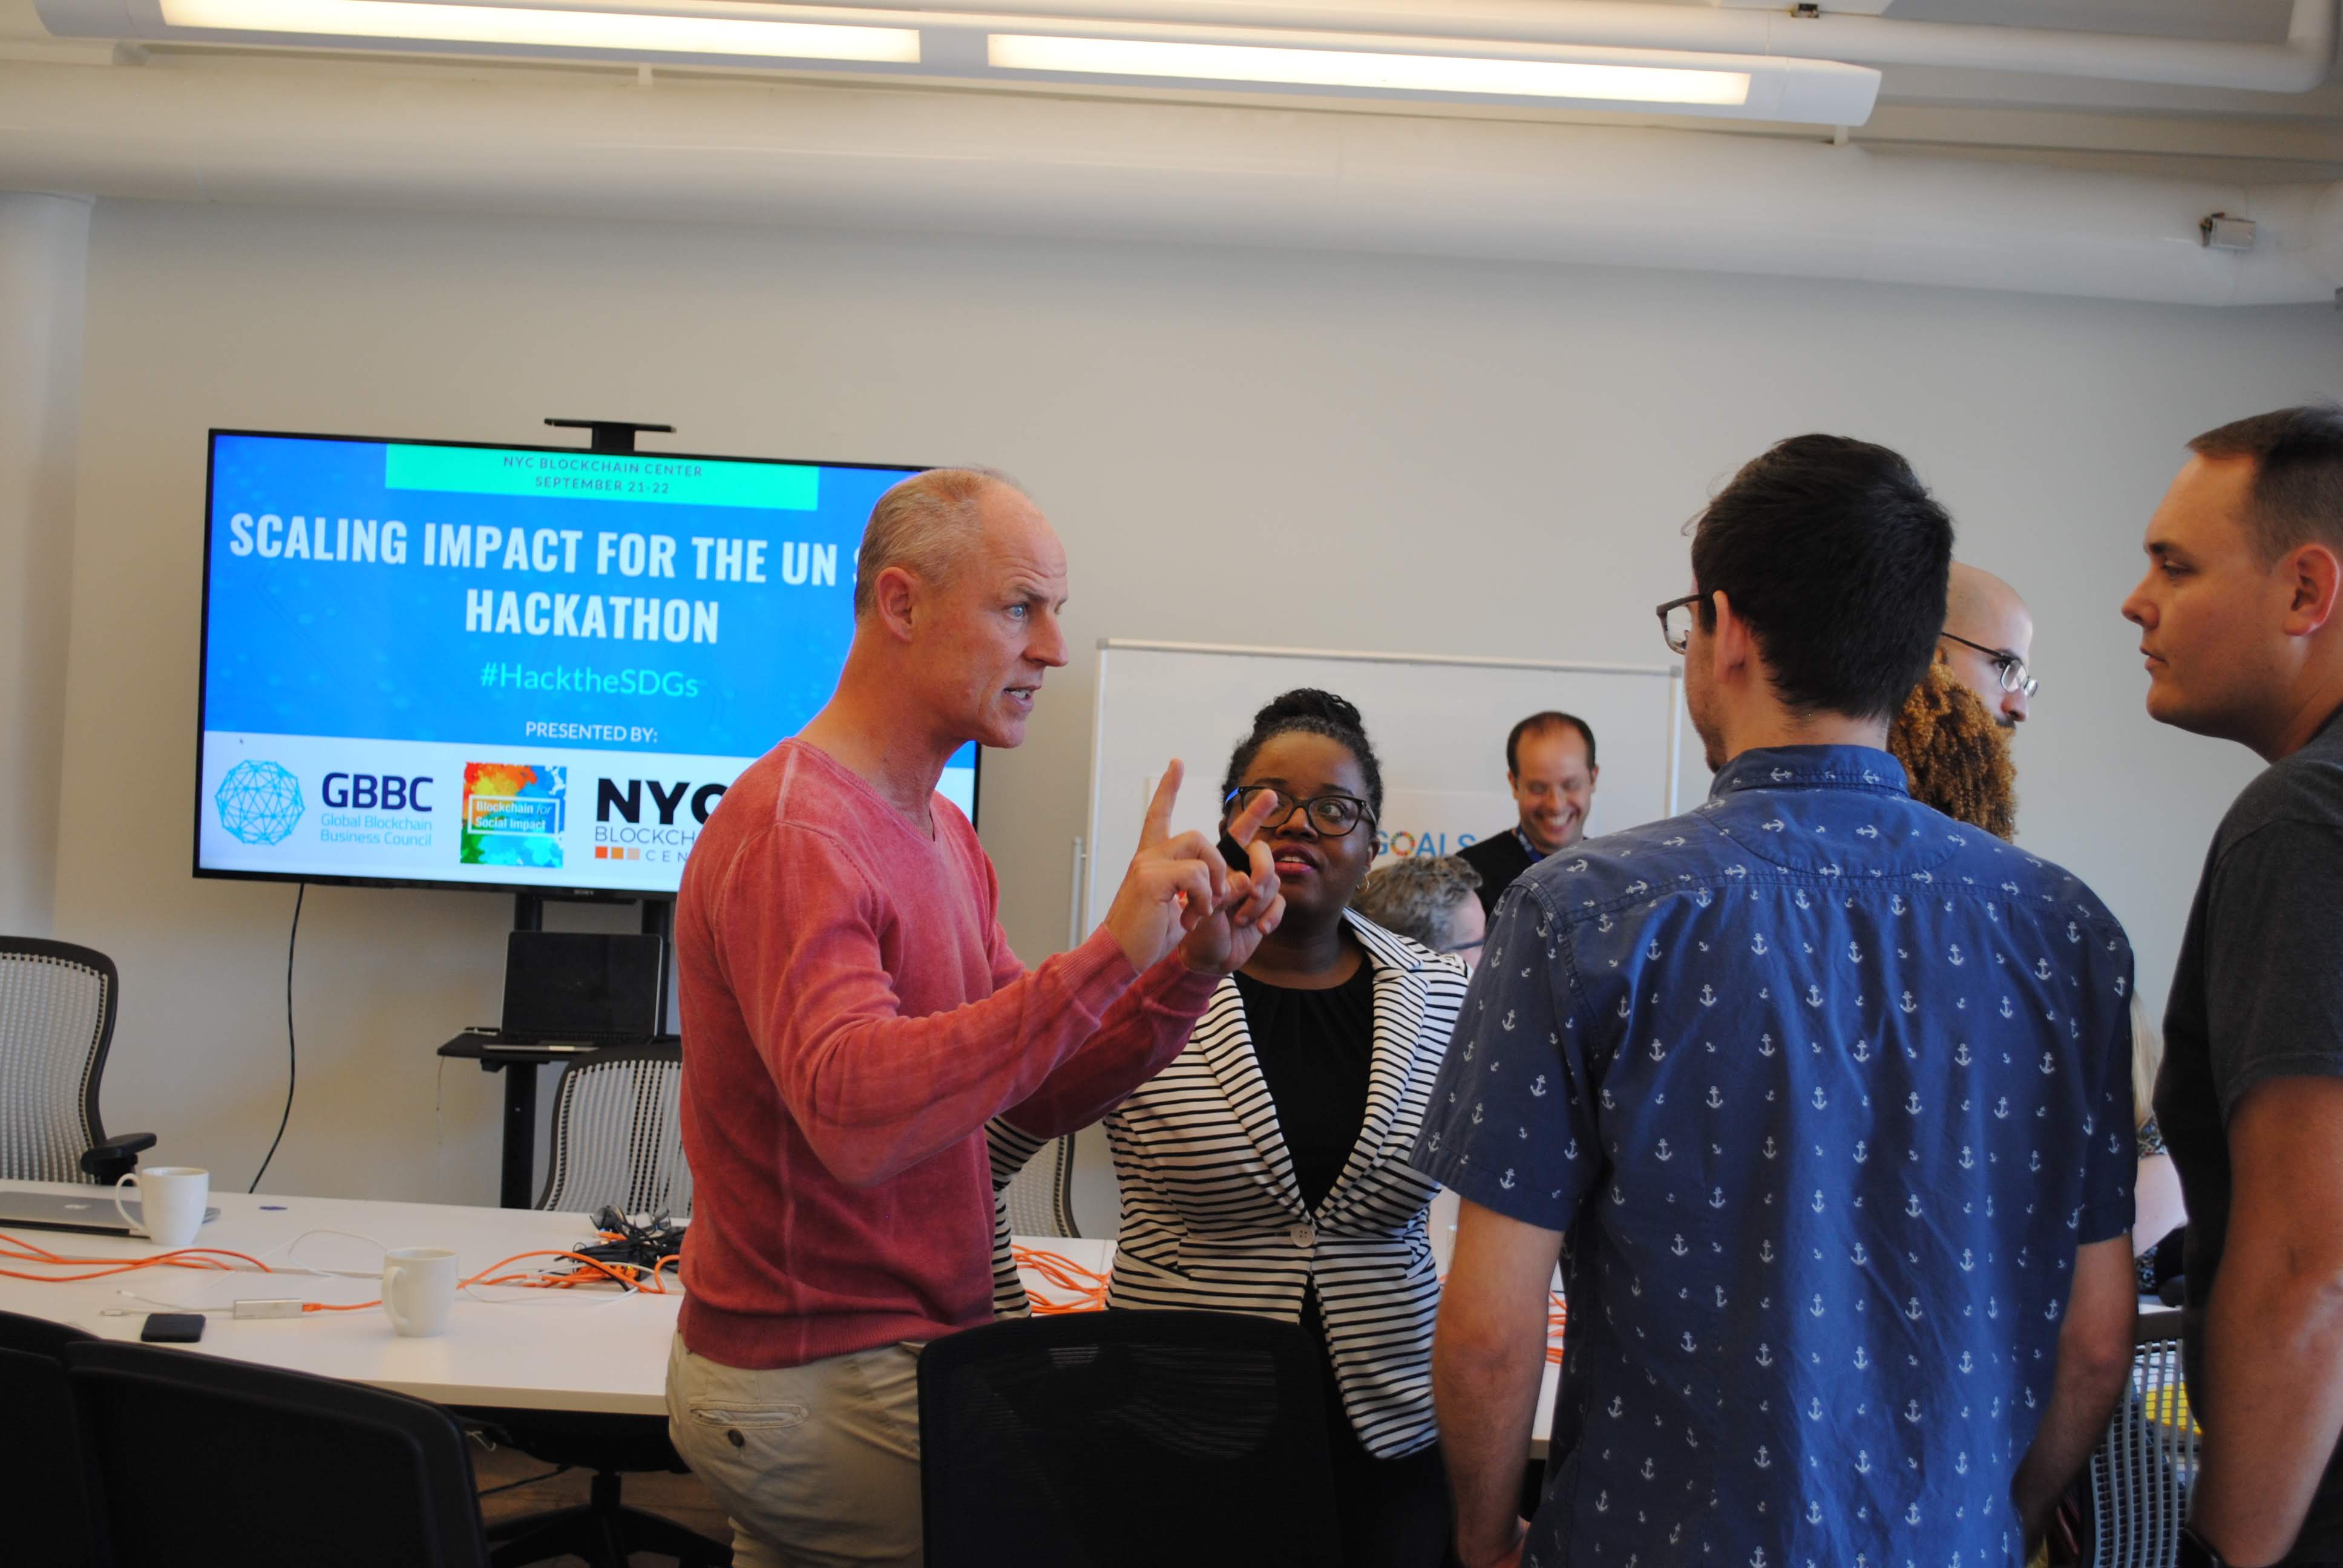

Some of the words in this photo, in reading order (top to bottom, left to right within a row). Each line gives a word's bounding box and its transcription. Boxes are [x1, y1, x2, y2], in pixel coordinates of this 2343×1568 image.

[503, 456, 535, 468] NYC
[540, 457, 640, 474] BLOCKCHAIN
[644, 463, 703, 477] CENTER
[535, 476, 623, 491] SEPTEMBER
[628, 480, 669, 494] 21-22
[230, 512, 407, 565] SCALING
[424, 522, 583, 574] IMPACT
[597, 531, 677, 578] FOR
[692, 536, 768, 583] THE
[782, 541, 838, 587] UN
[465, 589, 719, 644] HACKATHON
[480, 661, 700, 698] #HacktheSDGs
[525, 721, 628, 742] PRESENTED
[630, 726, 658, 744] BY:
[321, 772, 434, 812] GBBC
[596, 777, 730, 826] NYC
[476, 800, 534, 815] Blockchain
[537, 802, 552, 815] for
[320, 812, 361, 829] Global
[364, 814, 433, 831] Blockchain
[474, 815, 507, 829] Social
[510, 817, 546, 831] Impact
[320, 828, 381, 844] Business
[384, 831, 432, 847] Council
